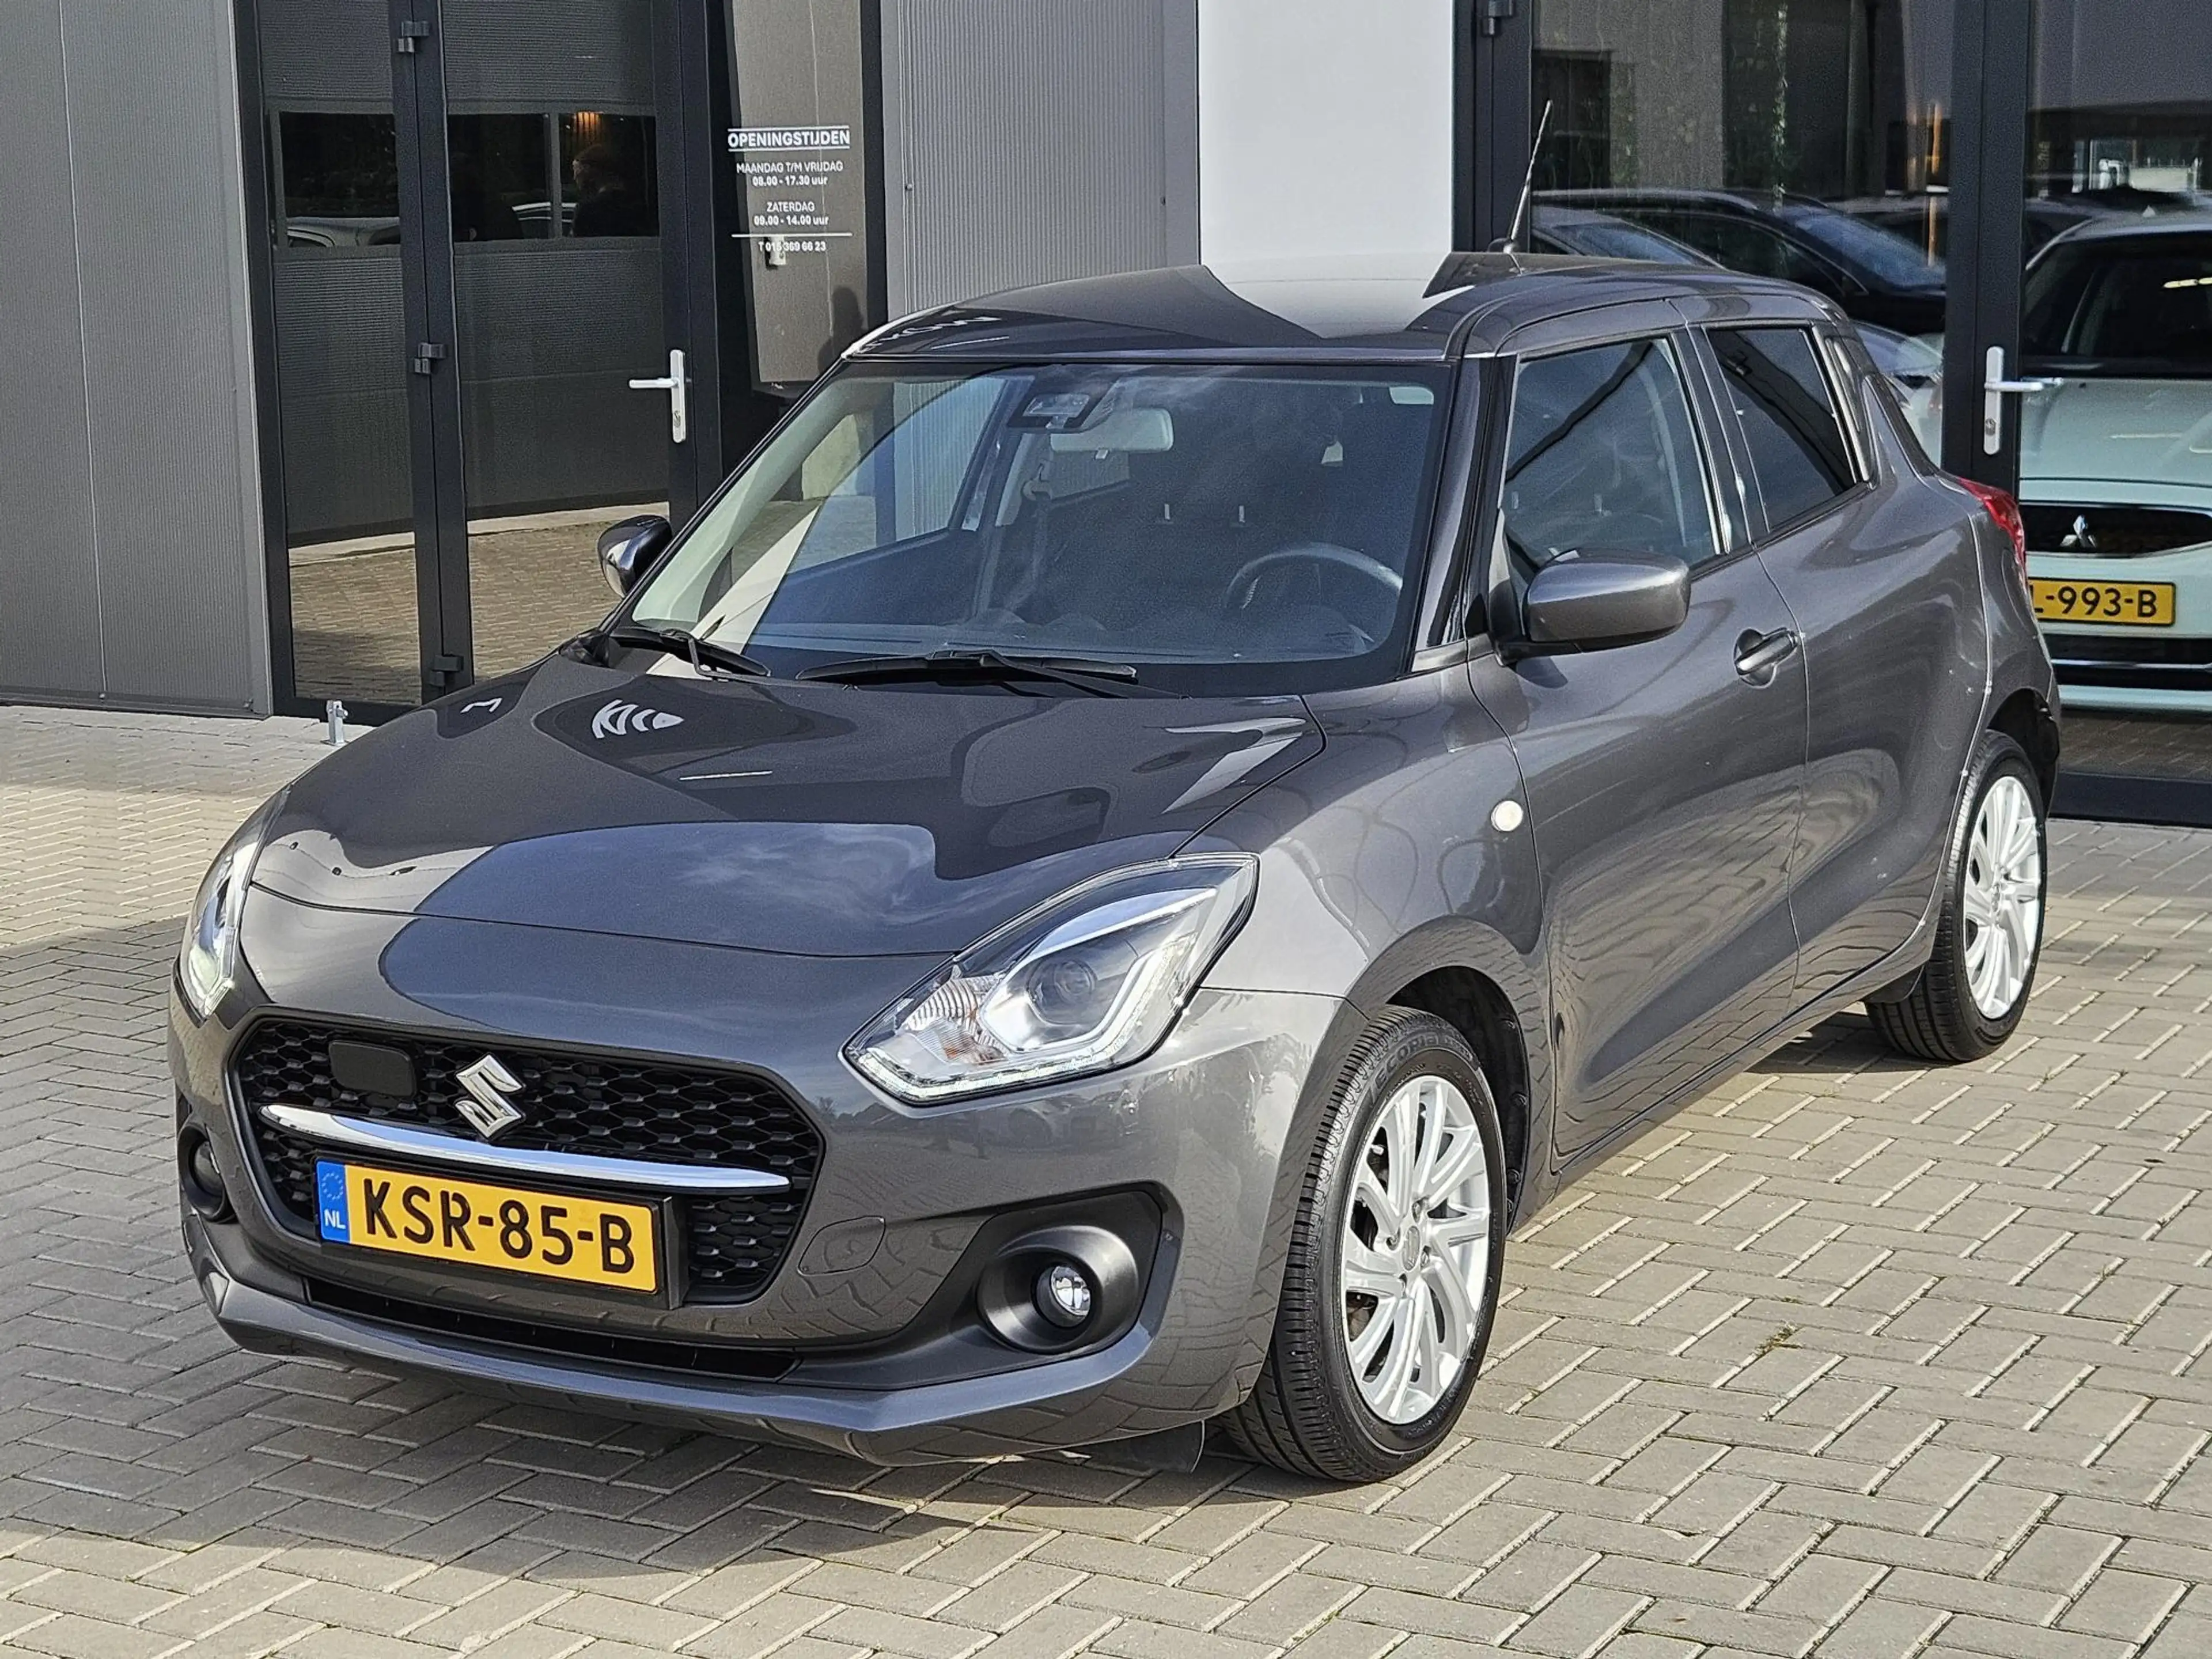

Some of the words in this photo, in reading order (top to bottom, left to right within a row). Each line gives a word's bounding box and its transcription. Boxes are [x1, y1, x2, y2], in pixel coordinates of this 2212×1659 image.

[728, 131, 850, 147] OPENINGSTIJDEN
[736, 162, 783, 173] MAANDAG
[786, 161, 802, 172] T/M
[804, 160, 843, 172] VRIJDAG
[752, 176, 778, 186] 08.00
[785, 175, 810, 185] 17.30
[812, 176, 828, 185] uur
[766, 201, 815, 212] ZATERDAG
[753, 215, 779, 226] 09.00
[786, 214, 811, 225] 14.00
[813, 216, 829, 225] uur
[758, 241, 764, 252] T
[815, 241, 826, 252] 23
[324, 1208, 346, 1230] NL
[362, 1177, 635, 1274] KSR-85-B
